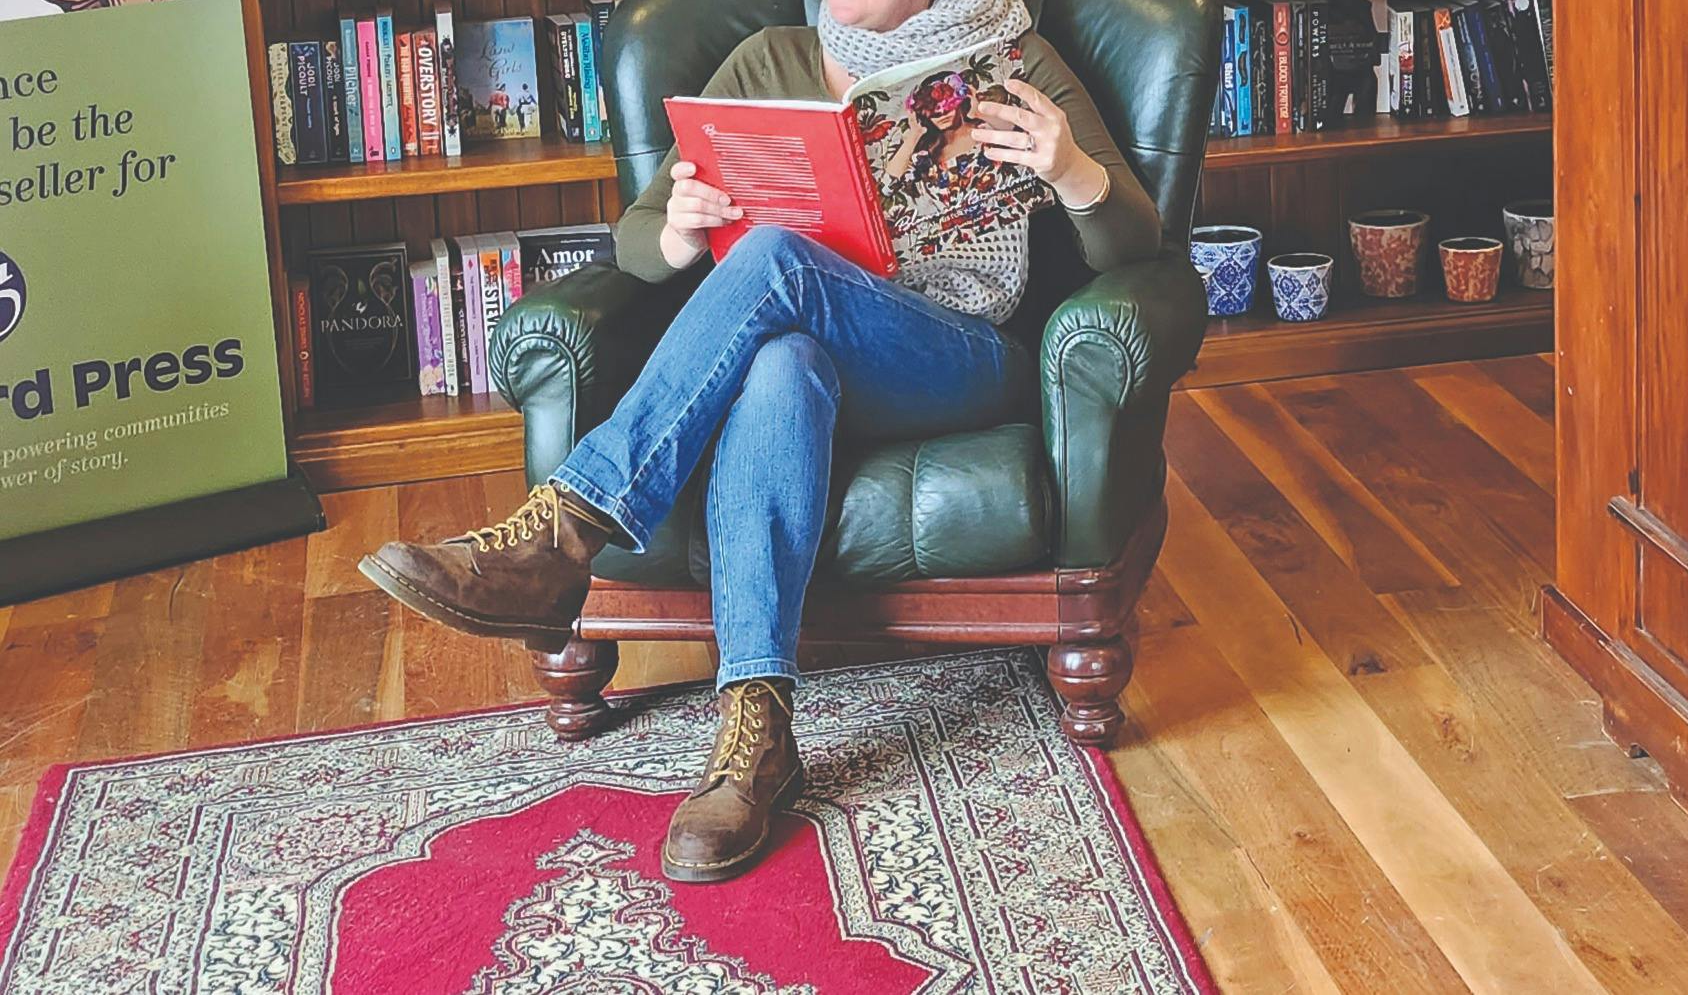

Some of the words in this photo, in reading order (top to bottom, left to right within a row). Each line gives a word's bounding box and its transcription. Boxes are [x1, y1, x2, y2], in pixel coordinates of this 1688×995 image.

[298, 55, 308, 96] PICOULT
[345, 66, 357, 107] Pilcher
[419, 47, 437, 126] OVERSTORY
[10, 117, 56, 152] be
[72, 105, 133, 141] the
[112, 149, 176, 197] for
[537, 248, 595, 265] Amor
[321, 314, 403, 333] PANDORA
[72, 338, 244, 408] Press
[104, 402, 229, 441] communities
[44, 460, 67, 483] of
[70, 450, 128, 474] story.
